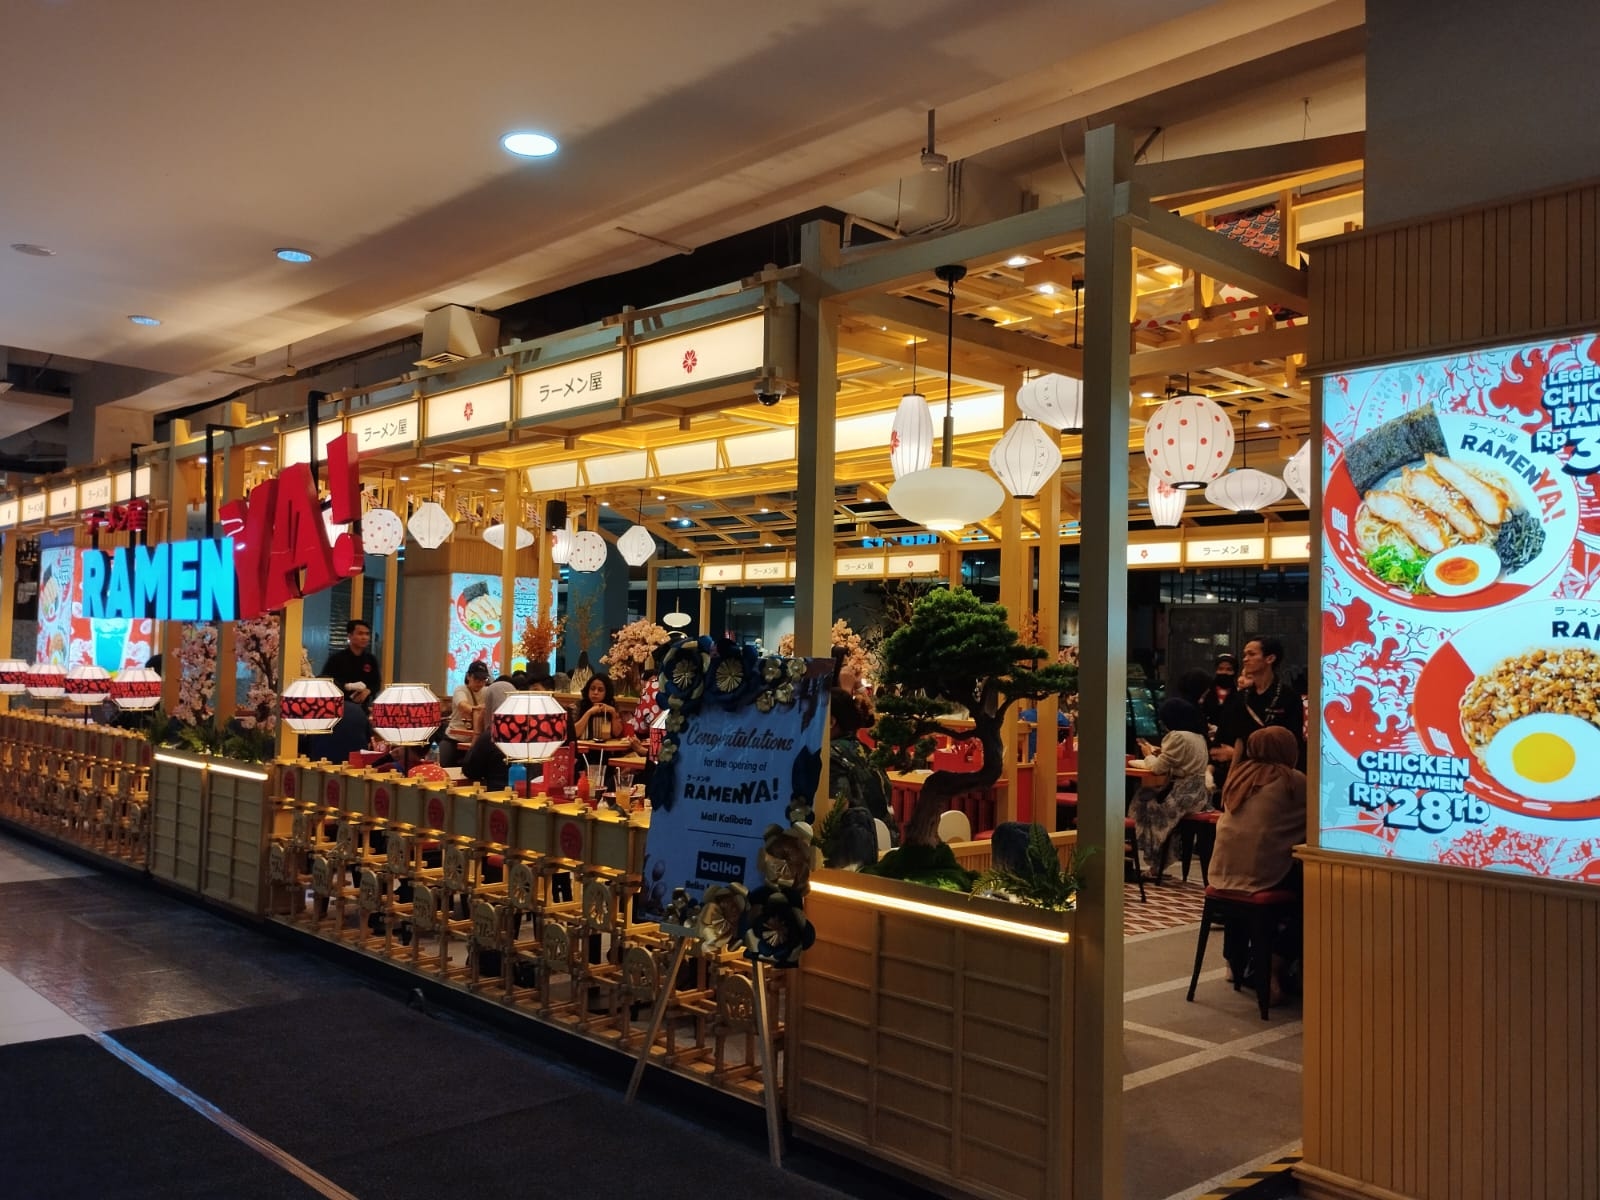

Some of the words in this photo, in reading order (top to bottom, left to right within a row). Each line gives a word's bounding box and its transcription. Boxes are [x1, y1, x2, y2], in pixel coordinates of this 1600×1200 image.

[539, 371, 603, 403] ラーメン屋
[363, 418, 408, 442] ラーメン屋
[1468, 421, 1519, 444] ラーメン屋
[1460, 434, 1566, 523] RAMENYA!
[1203, 544, 1249, 556] ラーメン屋
[686, 722, 795, 752] Congratulations
[704, 756, 714, 768] for
[715, 757, 727, 769] the
[728, 759, 758, 773] opening
[759, 761, 768, 771] of
[1359, 751, 1470, 778] CHICKEN
[683, 777, 779, 805] RAMENYA!
[1367, 772, 1464, 792] DRYRAMEN
[700, 811, 718, 821] Mall
[719, 813, 753, 826] Kalibata
[711, 839, 731, 849] From
